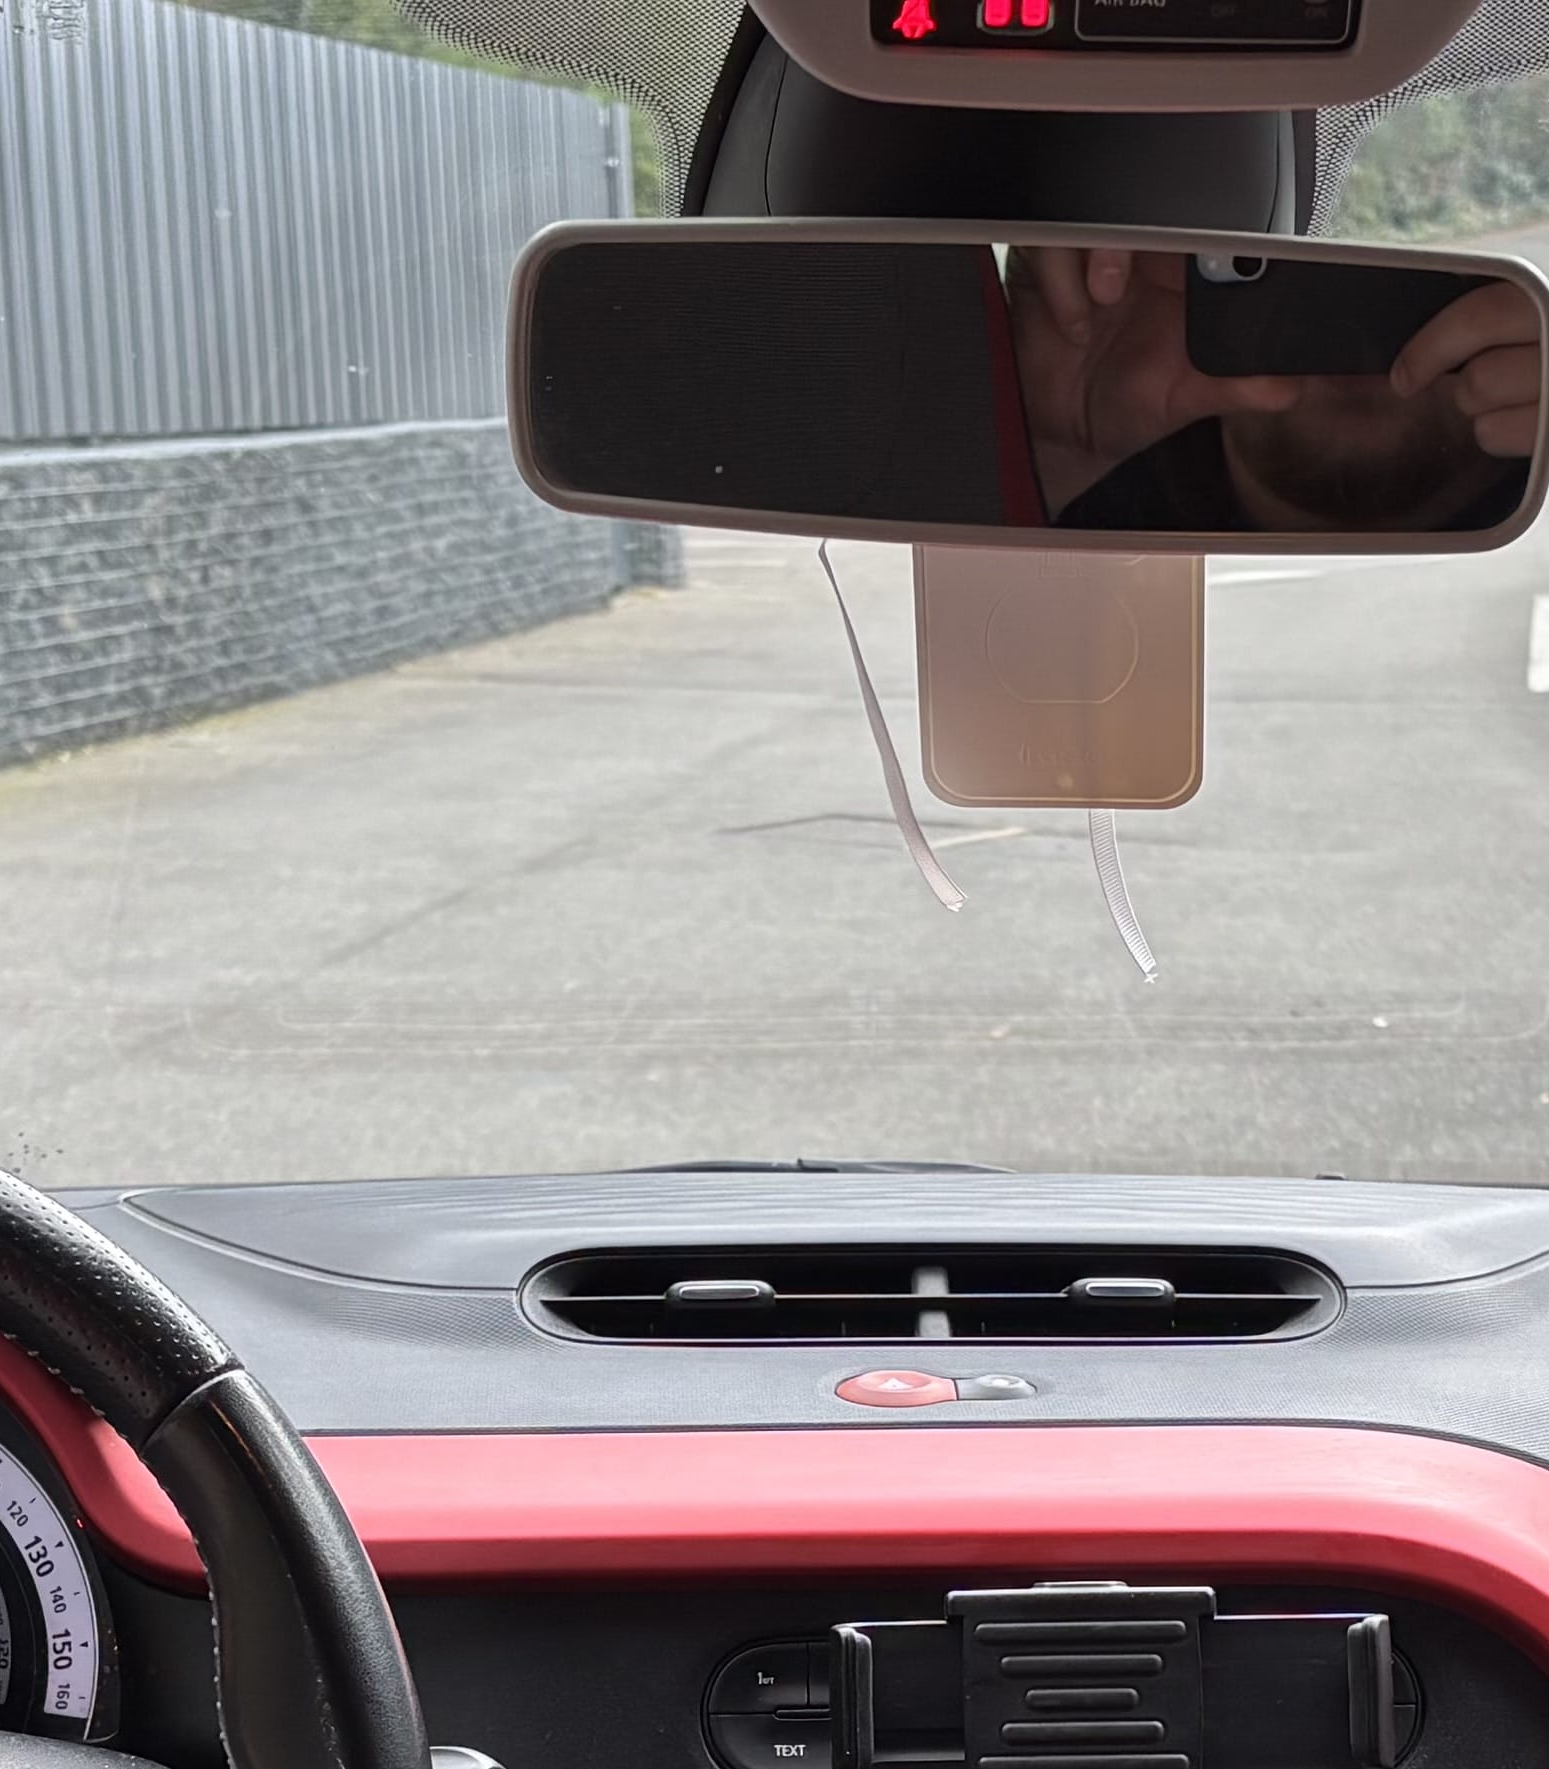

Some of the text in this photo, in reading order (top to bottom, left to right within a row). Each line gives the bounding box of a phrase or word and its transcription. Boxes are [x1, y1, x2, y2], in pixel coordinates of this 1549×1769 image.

[5, 1500, 30, 1528] 120
[23, 1535, 56, 1578] 130
[49, 1585, 68, 1614] 140
[51, 1628, 73, 1671] 150
[54, 1682, 71, 1711] 160
[773, 1744, 807, 1757] TEXT
